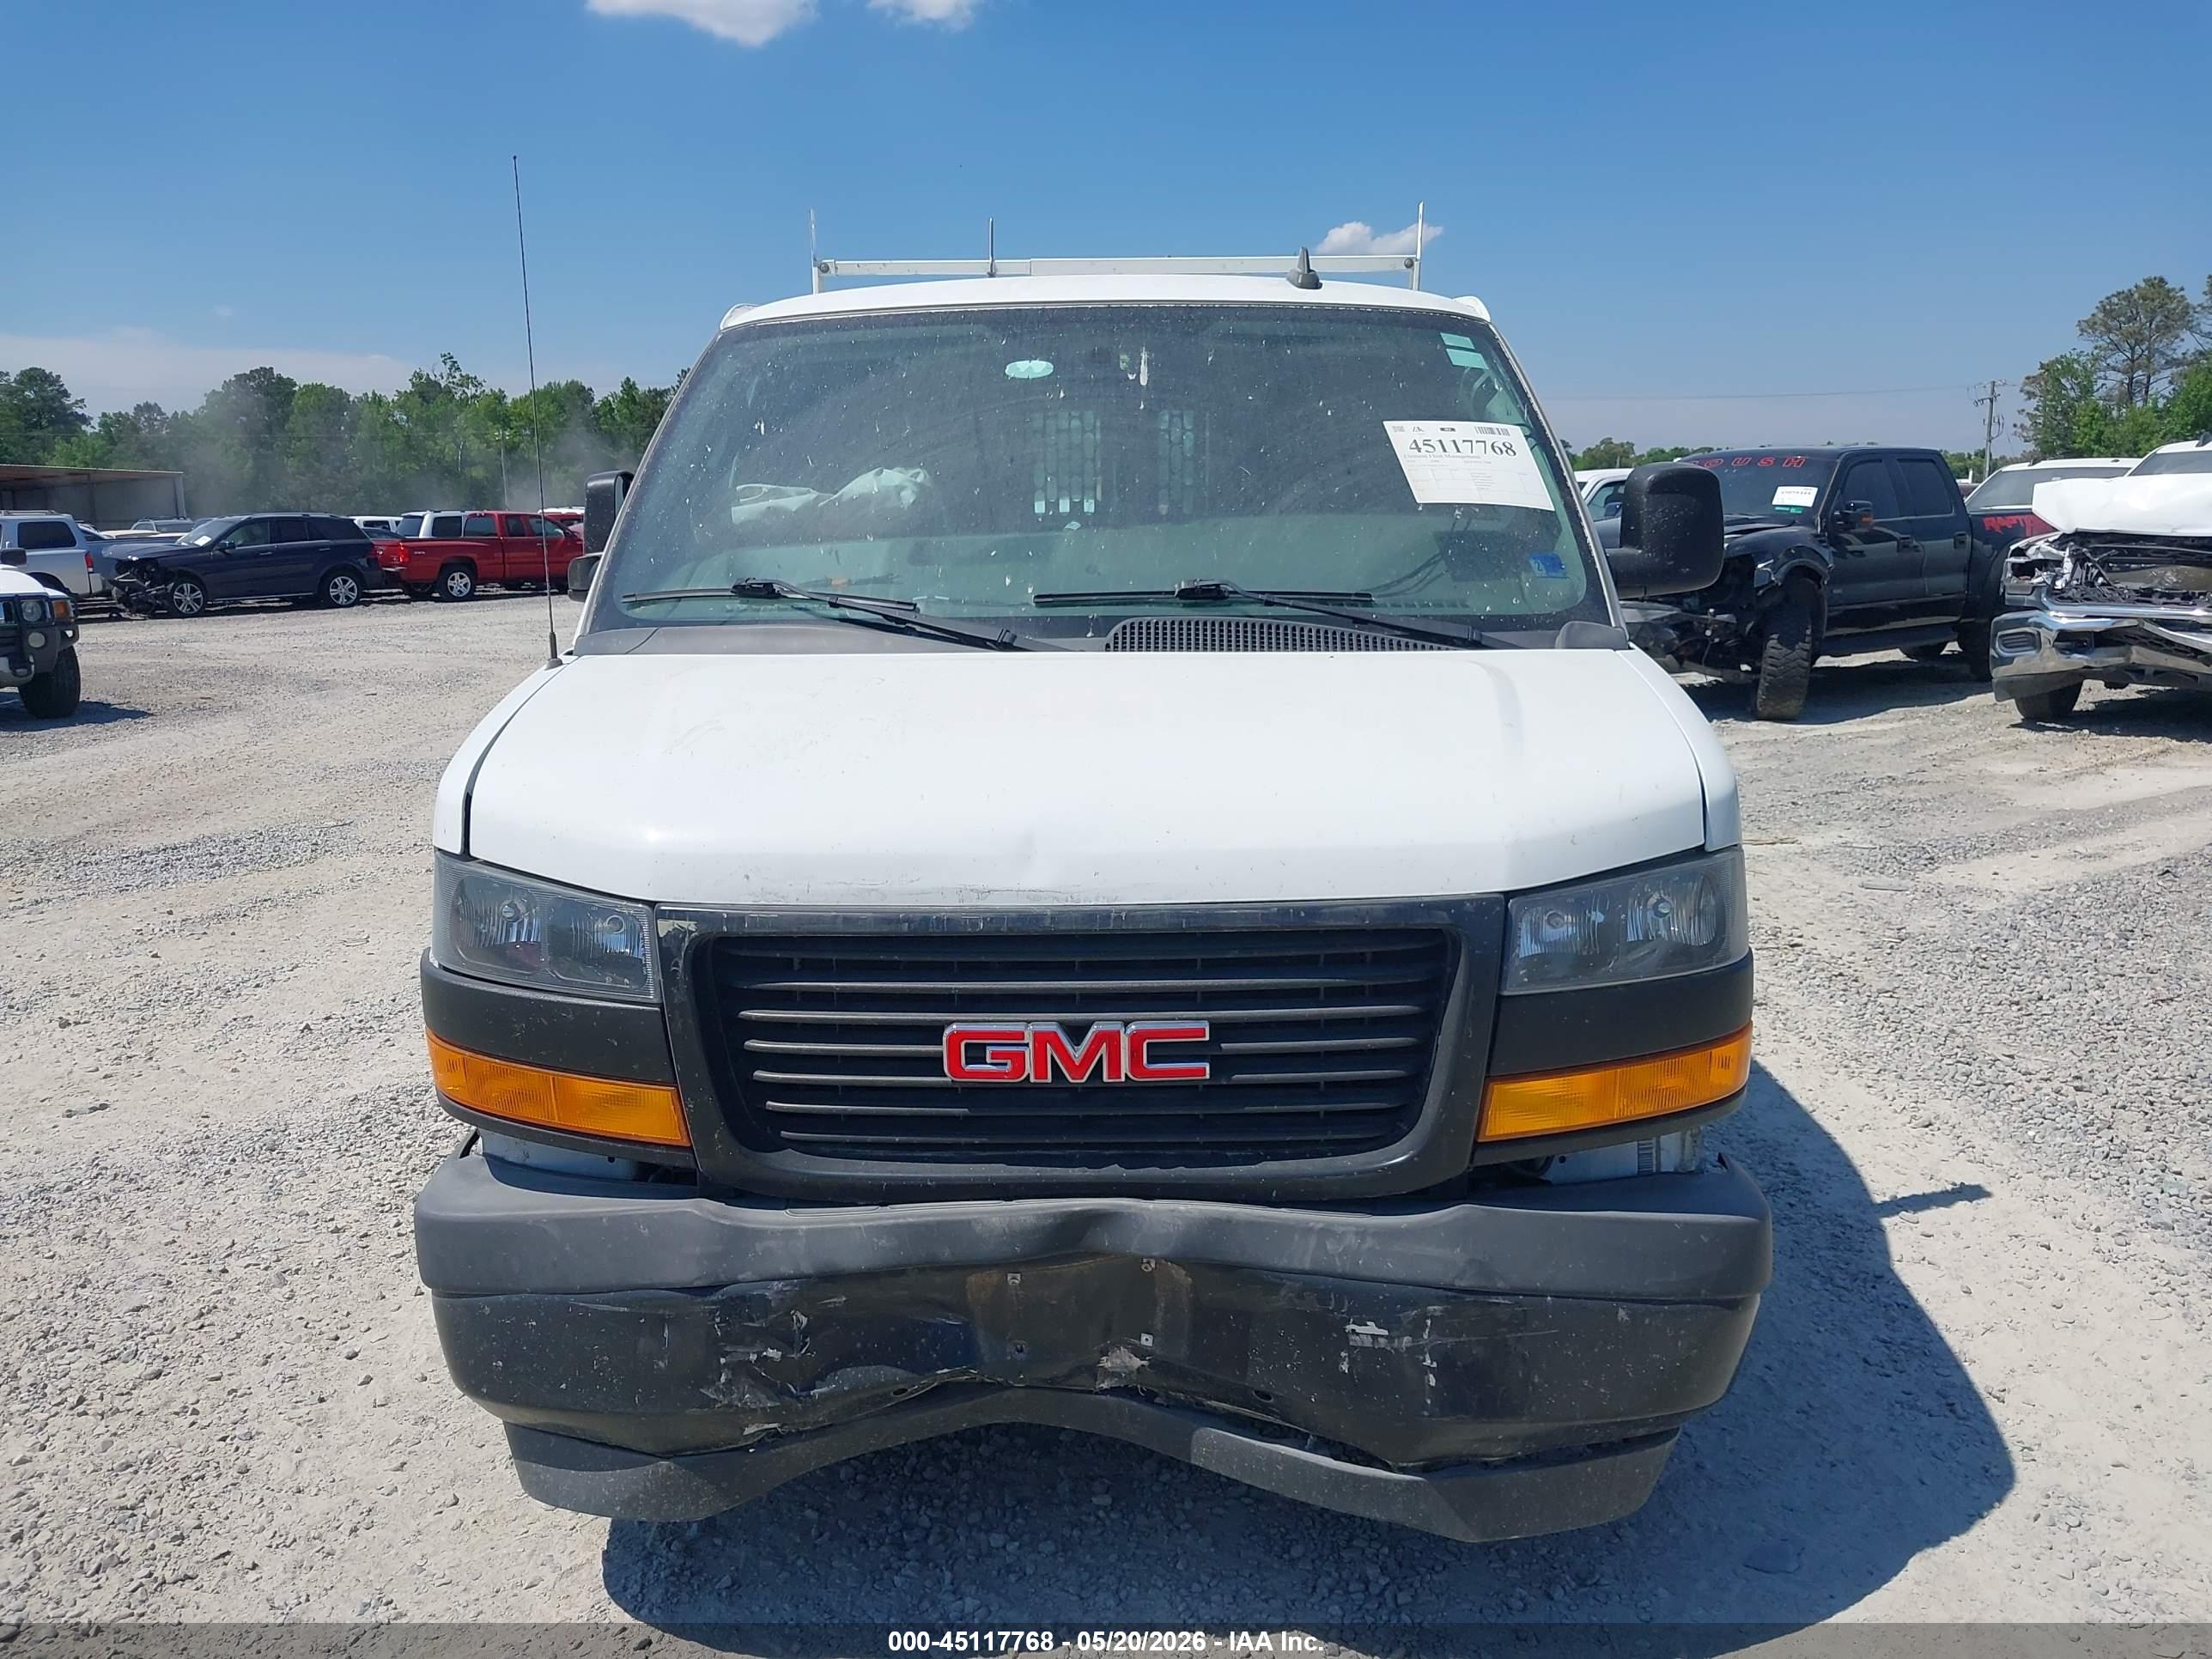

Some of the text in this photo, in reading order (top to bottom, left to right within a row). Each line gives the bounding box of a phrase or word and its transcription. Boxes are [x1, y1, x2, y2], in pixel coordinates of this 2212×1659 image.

[1409, 439, 1516, 456] 45117768
[1690, 456, 1807, 468] OUSH
[943, 1020, 1210, 1083] GMC
